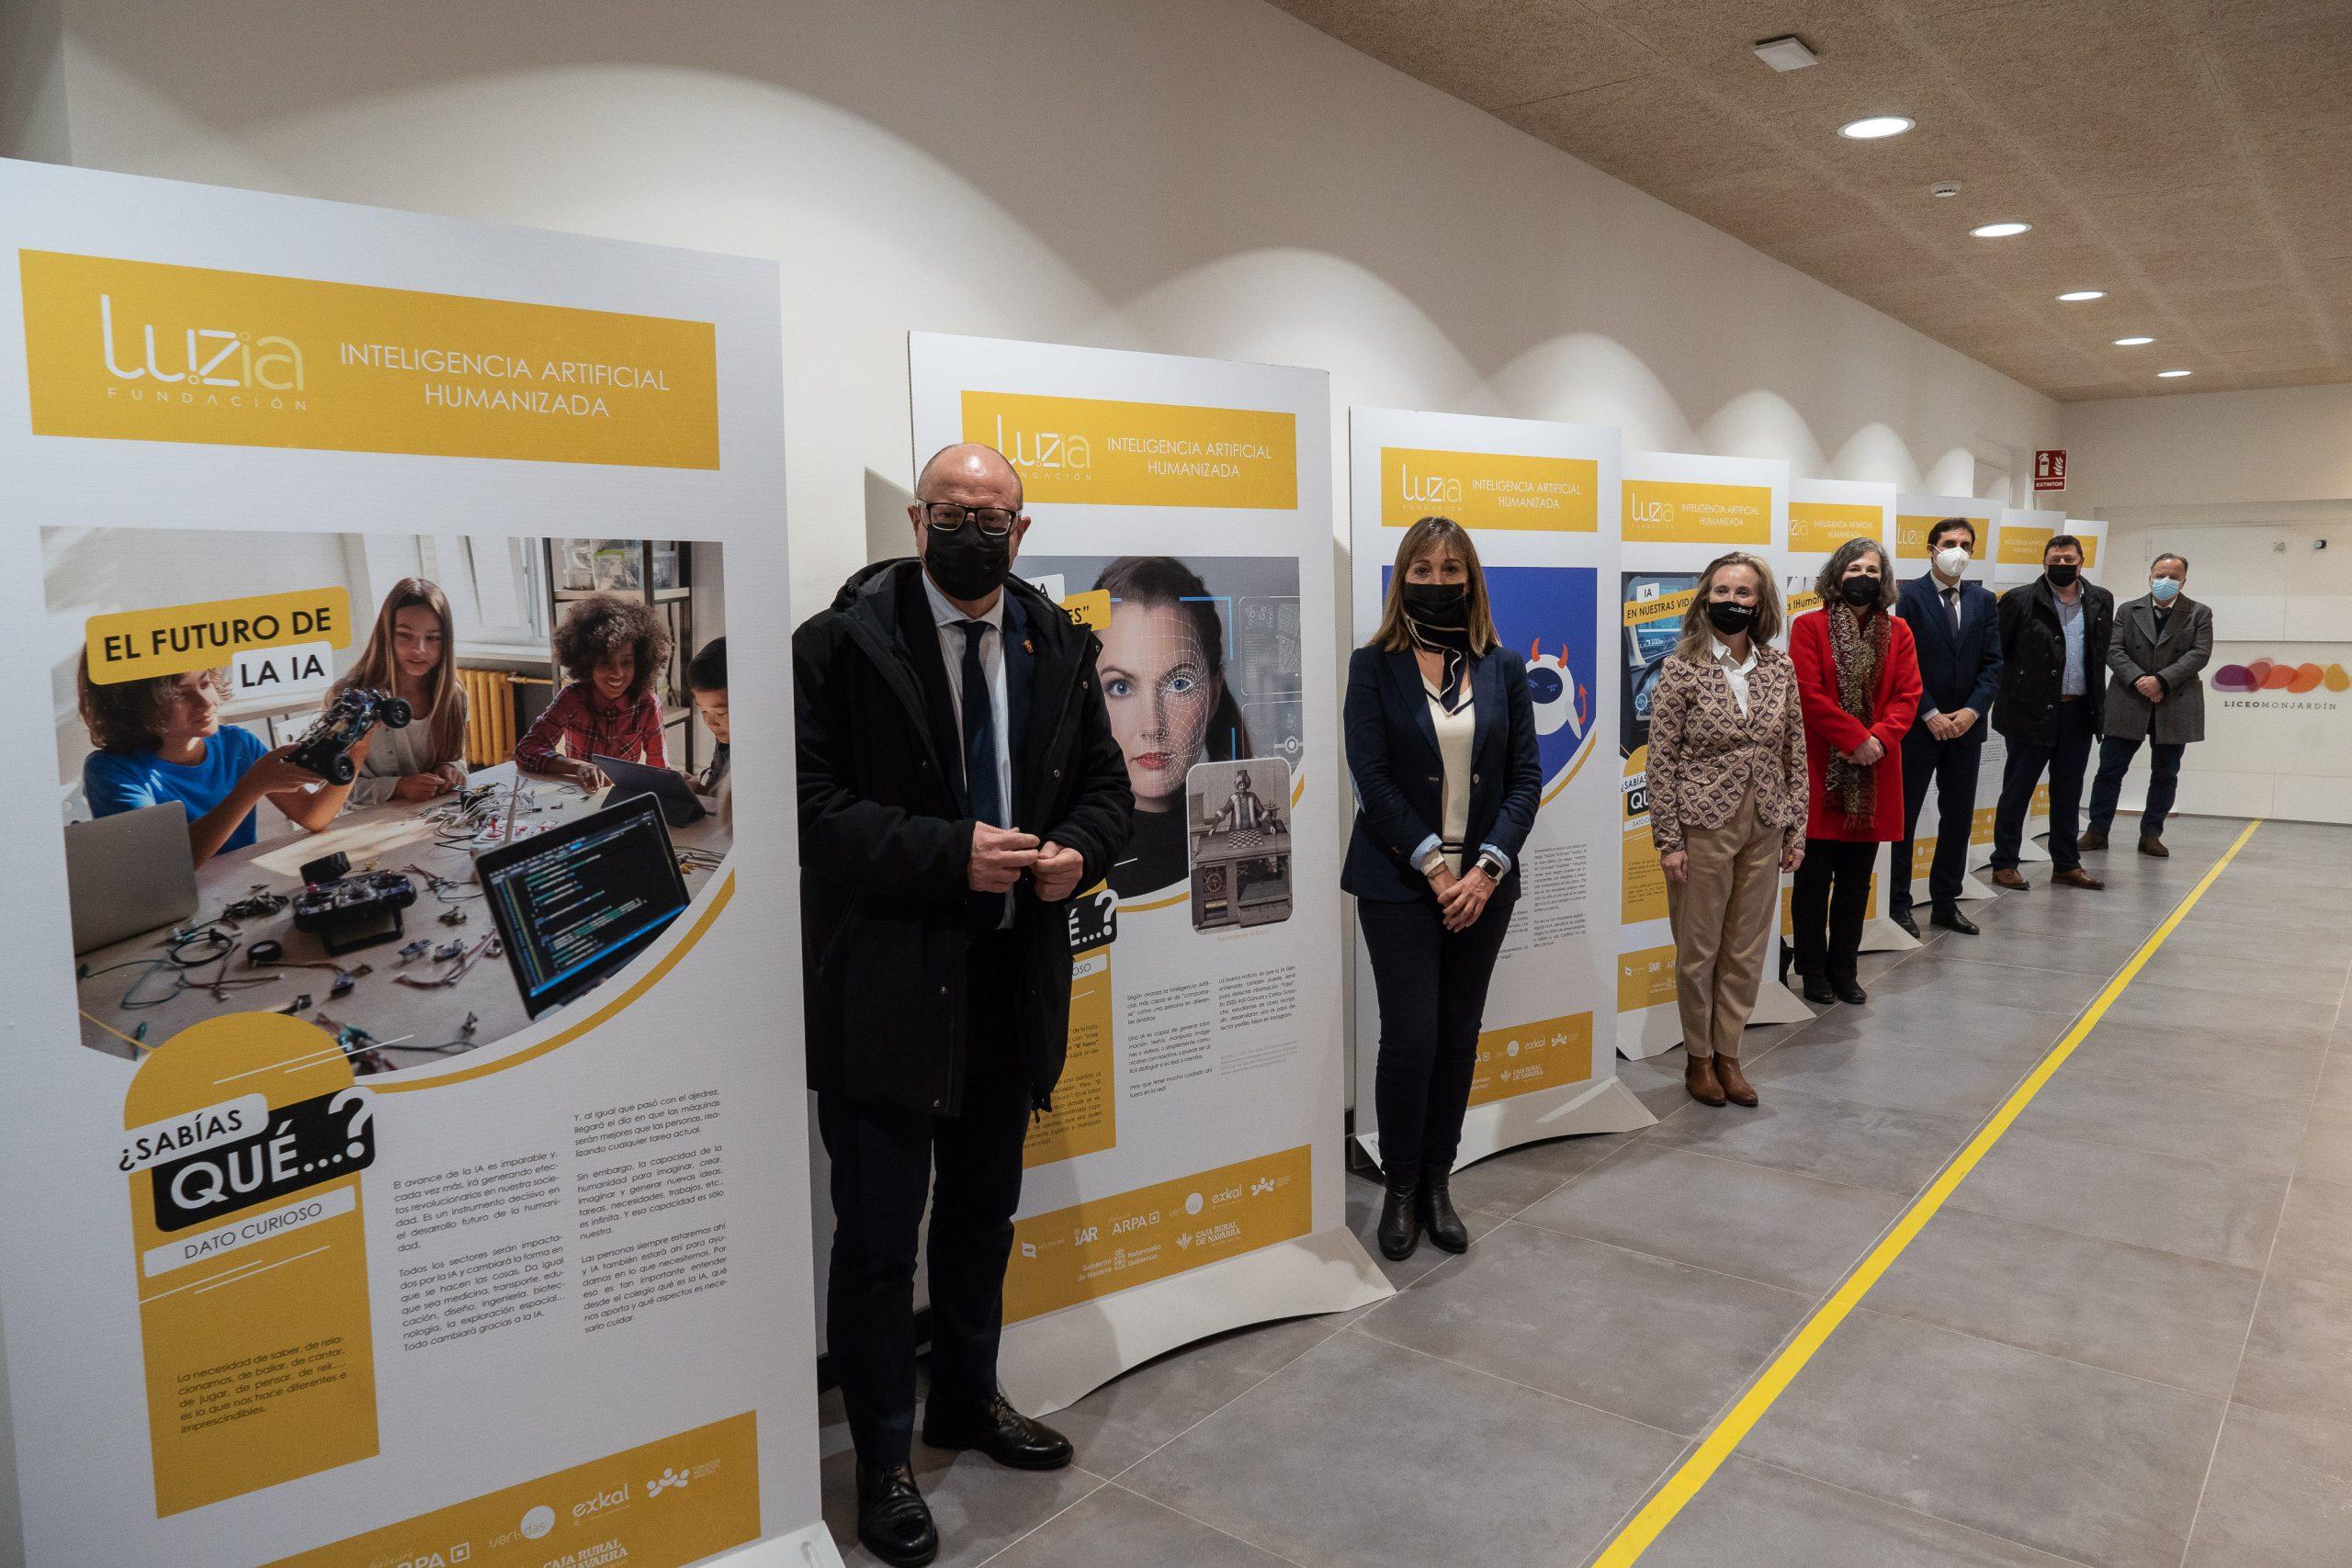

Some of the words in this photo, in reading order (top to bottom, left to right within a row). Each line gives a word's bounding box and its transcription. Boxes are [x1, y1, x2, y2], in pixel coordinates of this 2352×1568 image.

[340, 342, 534, 380] INTELIGENCIA
[540, 360, 671, 391] ARTIFICIAL
[107, 388, 308, 412] FUNDACIÓN
[424, 383, 611, 418] HUMANIZADA
[1107, 436, 1203, 457] INTELIGENCIA
[1205, 441, 1272, 459] ARTIFICIAL
[1148, 461, 1240, 478] HUMANIZADA
[1472, 479, 1534, 493] INTELIGENCIA
[1536, 481, 1581, 495] ARTIFICIAL
[1498, 497, 1560, 509] HUMANIZADA
[1627, 608, 1637, 619] EN
[1639, 600, 1675, 616] NUESTRAS
[1677, 597, 1693, 608] VID
[1644, 588, 1653, 598] IA
[104, 634, 141, 662] EL
[152, 615, 280, 656] FUTURO
[291, 607, 332, 636] DE
[241, 660, 280, 688] LA
[292, 654, 325, 681] IA
[573, 1120, 605, 1134] llegará
[606, 1119, 616, 1128] el
[617, 1116, 632, 1125] día
[634, 1114, 646, 1122] en
[648, 1111, 665, 1121] que
[667, 1108, 679, 1116] las
[681, 1100, 720, 1113] máquinas
[583, 1111, 593, 1120] al
[594, 1107, 616, 1120] igual
[617, 1105, 636, 1114] que
[637, 1099, 659, 1111] pasó
[660, 1097, 677, 1106] con
[678, 1094, 686, 1102] el
[119, 1109, 243, 1171] ¿SABÍAS
[574, 1134, 599, 1146] serán
[600, 1129, 634, 1141] mejores
[634, 1125, 651, 1134] que
[652, 1122, 664, 1131] las
[704, 1111, 720, 1120] rea-
[575, 1145, 606, 1157] lizando
[607, 1137, 648, 1151] cualquier
[649, 1133, 672, 1143] tarea
[393, 1180, 401, 1190] El
[404, 1174, 443, 1188] avance
[446, 1170, 459, 1179] de
[462, 1168, 472, 1176] la
[474, 1165, 485, 1173] IA
[487, 1163, 498, 1171] es
[501, 1153, 548, 1168] imparable
[393, 1190, 422, 1202] cada
[424, 1187, 441, 1196] vez
[467, 1177, 480, 1188] irá
[481, 1168, 533, 1187] generando
[535, 1164, 559, 1174] efec-
[395, 1206, 410, 1214] tos
[411, 1190, 482, 1212] revolucionarios
[483, 1188, 496, 1197] en
[497, 1180, 532, 1193] nuestra
[533, 1176, 560, 1186] socie-
[423, 1213, 433, 1222] Es
[435, 1211, 448, 1219] un
[451, 1198, 505, 1215] instrumento
[507, 1190, 546, 1203] decisivo
[548, 1187, 560, 1195] en
[1212, 1184, 1243, 1204] exkal
[184, 1231, 236, 1259] DATO
[242, 1202, 322, 1239] CURIOSO
[396, 1231, 406, 1241] el
[410, 1221, 458, 1237] desarrollo
[461, 1214, 490, 1225] futuro
[492, 1210, 507, 1219] de
[511, 1207, 520, 1215] la
[524, 1198, 560, 1213] humani-
[1112, 1215, 1147, 1235] ARPA
[572, 1483, 630, 1517] exkal
[577, 1538, 622, 1560] RURAL
